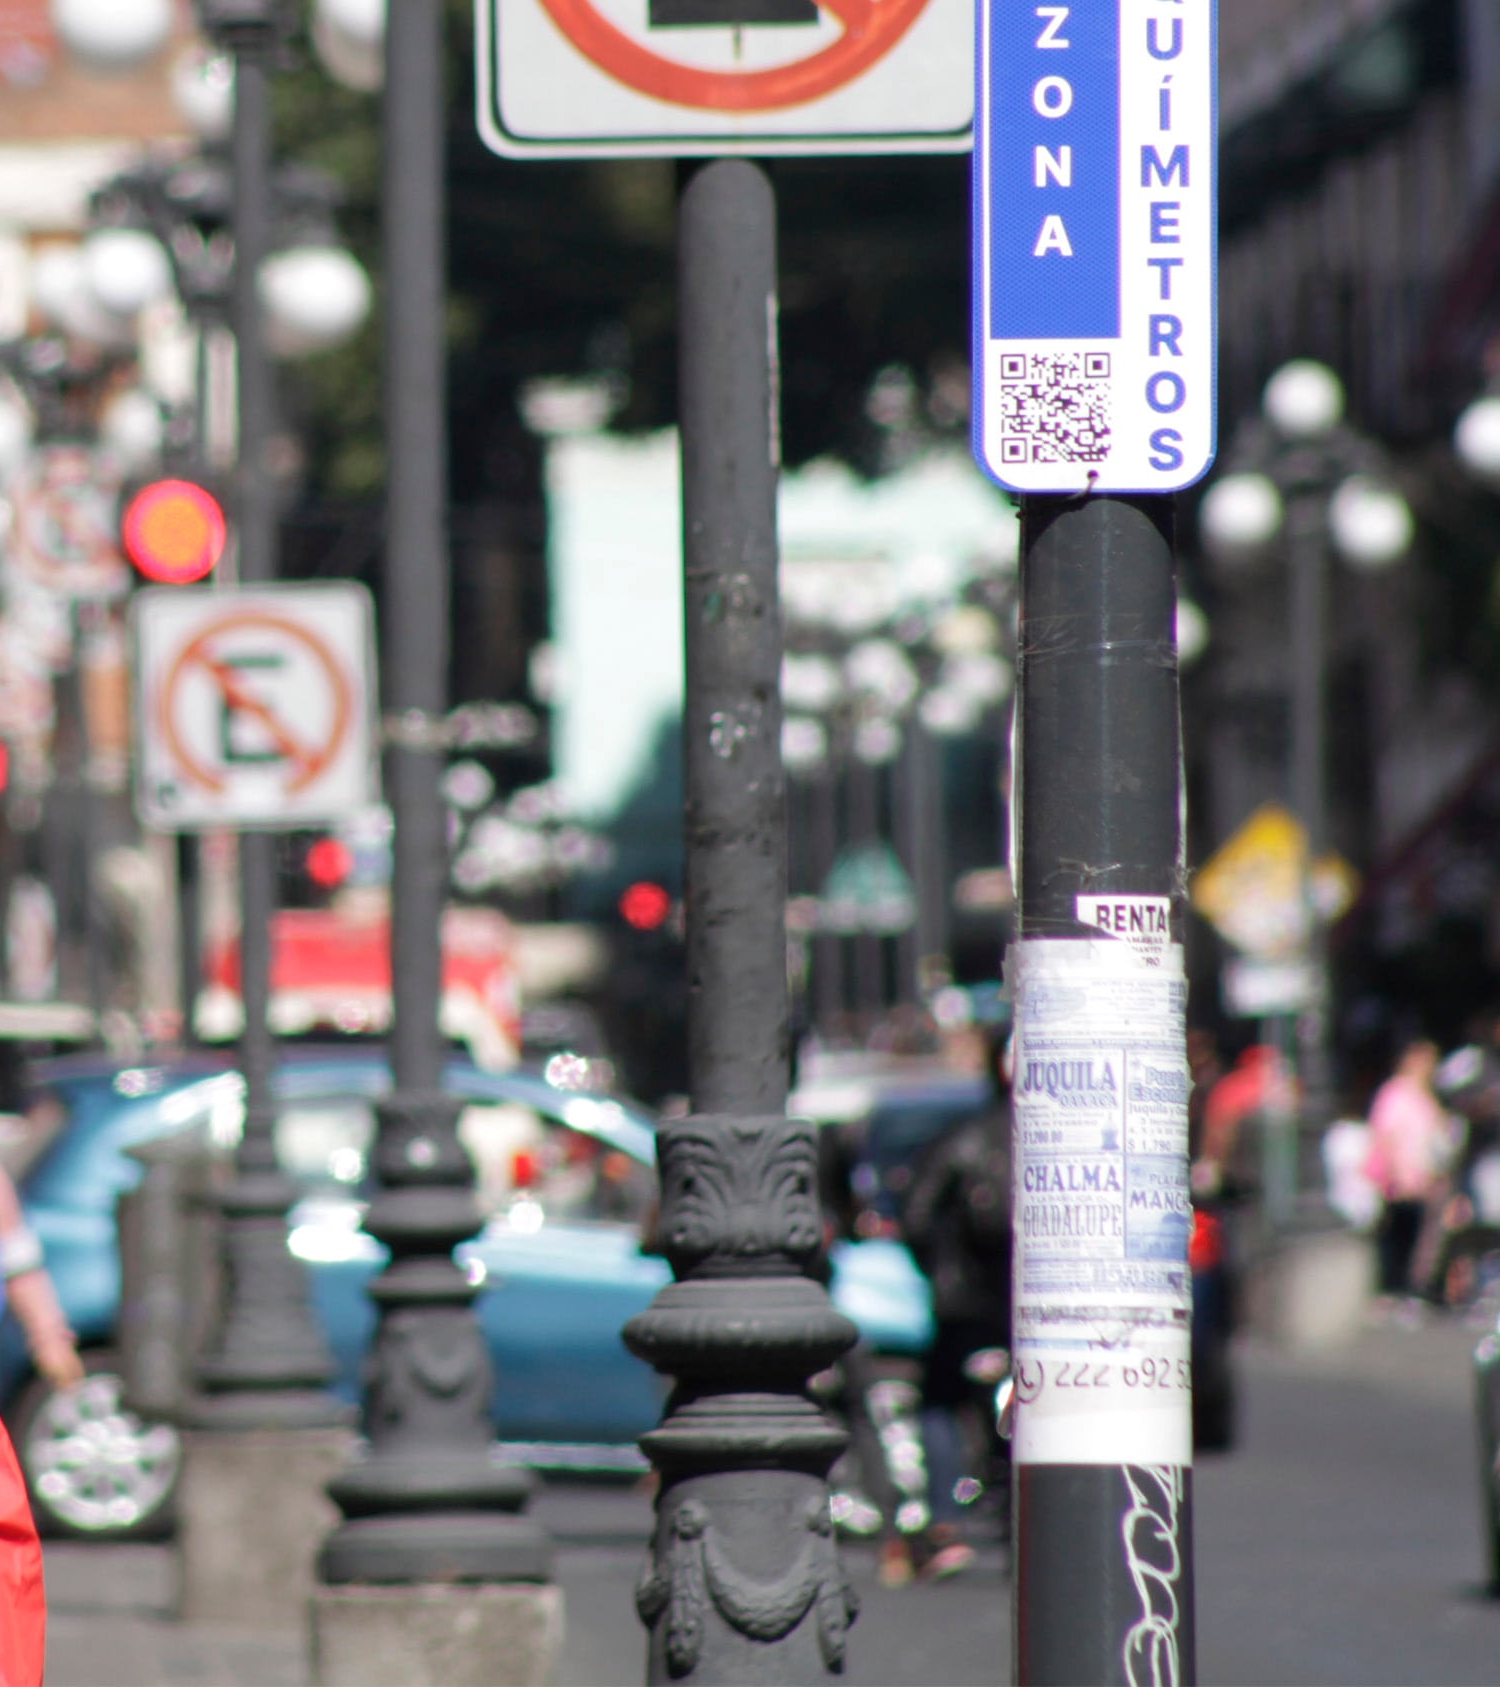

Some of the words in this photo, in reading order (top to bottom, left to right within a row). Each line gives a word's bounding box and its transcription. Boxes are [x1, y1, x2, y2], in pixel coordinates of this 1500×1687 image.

[1033, 6, 1073, 257] ZONA
[1140, 0, 1190, 472] UÍMETROS
[1096, 904, 1167, 933] RENTA
[1023, 1060, 1117, 1098] JUQUILA
[1023, 1164, 1122, 1193] CHALMA
[1022, 1203, 1123, 1237] GUADALUPE
